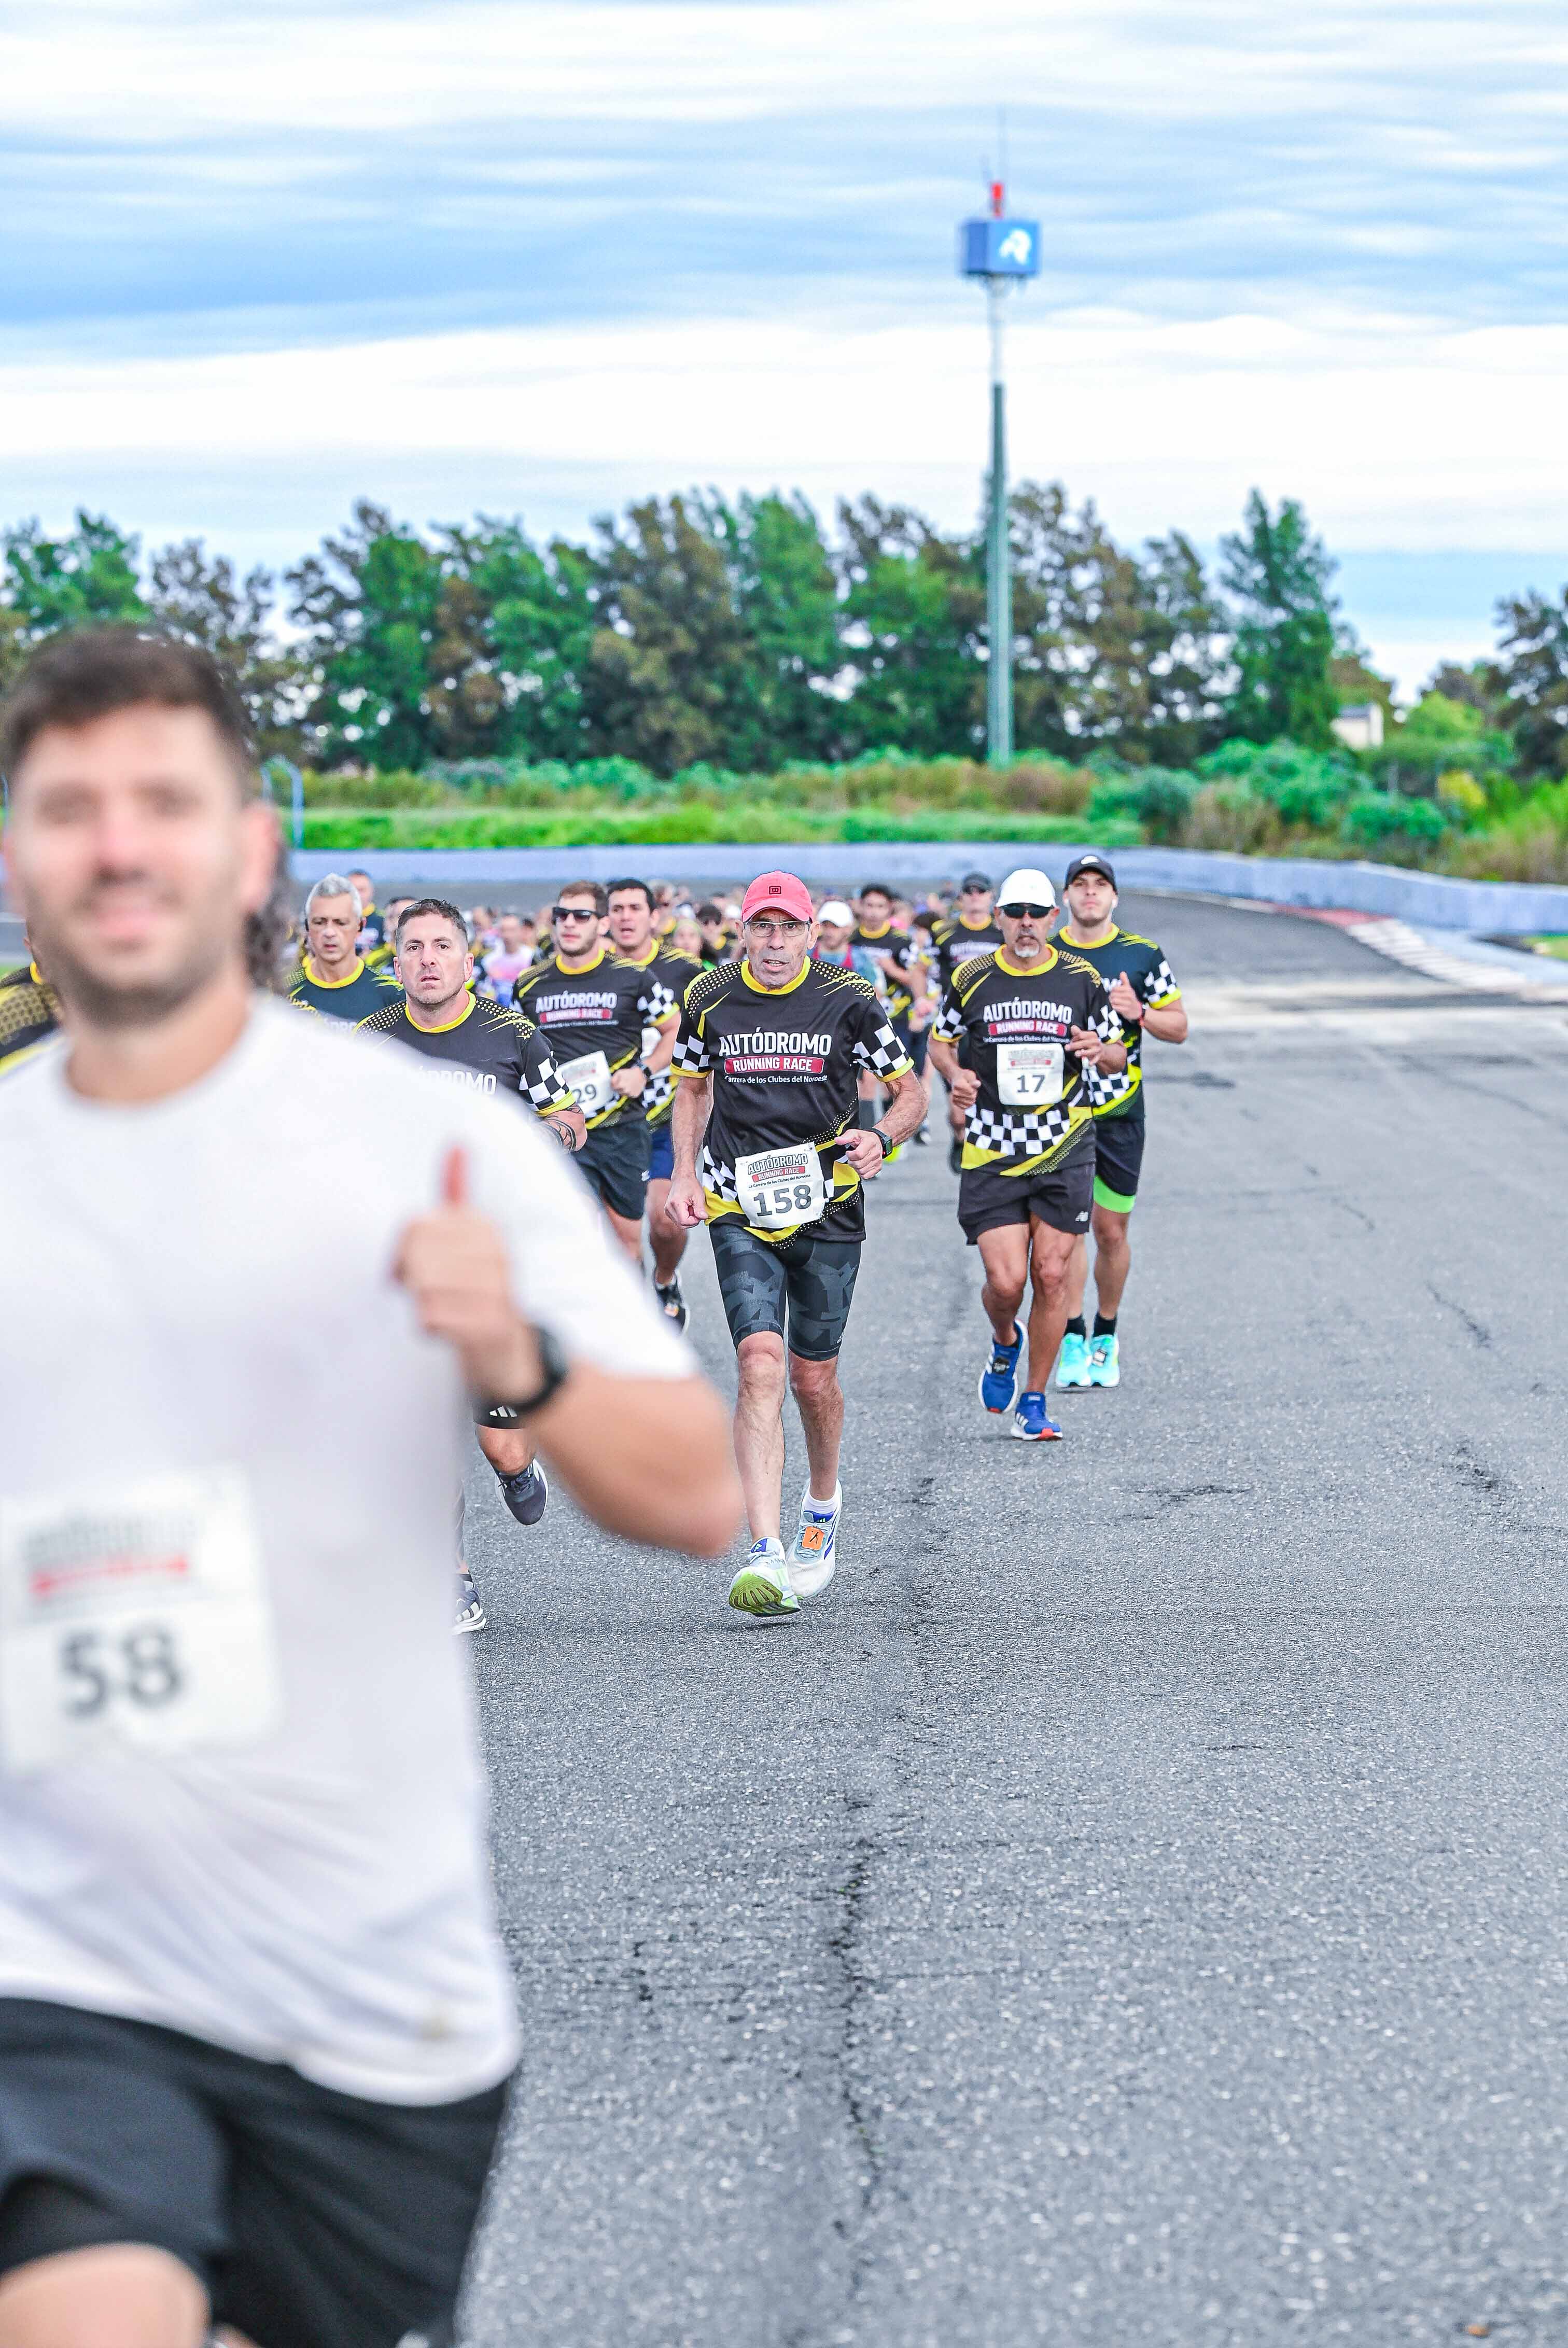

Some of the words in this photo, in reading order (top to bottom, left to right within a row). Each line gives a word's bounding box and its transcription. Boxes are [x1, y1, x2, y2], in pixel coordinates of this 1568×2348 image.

[535, 990, 618, 1014] AUTÓDROMO
[983, 996, 1072, 1024] AUTÓDROMO
[719, 1027, 832, 1057] AUTÓDROMO
[733, 1057, 780, 1072] RUNNING
[783, 1057, 813, 1071] RACE
[571, 1084, 597, 1104] 29
[1017, 1074, 1045, 1093] 17
[748, 1153, 808, 1175] AUTÓDROMO
[758, 1169, 783, 1180] RUNNING
[753, 1184, 812, 1217] 158
[61, 1622, 185, 1718] 58
